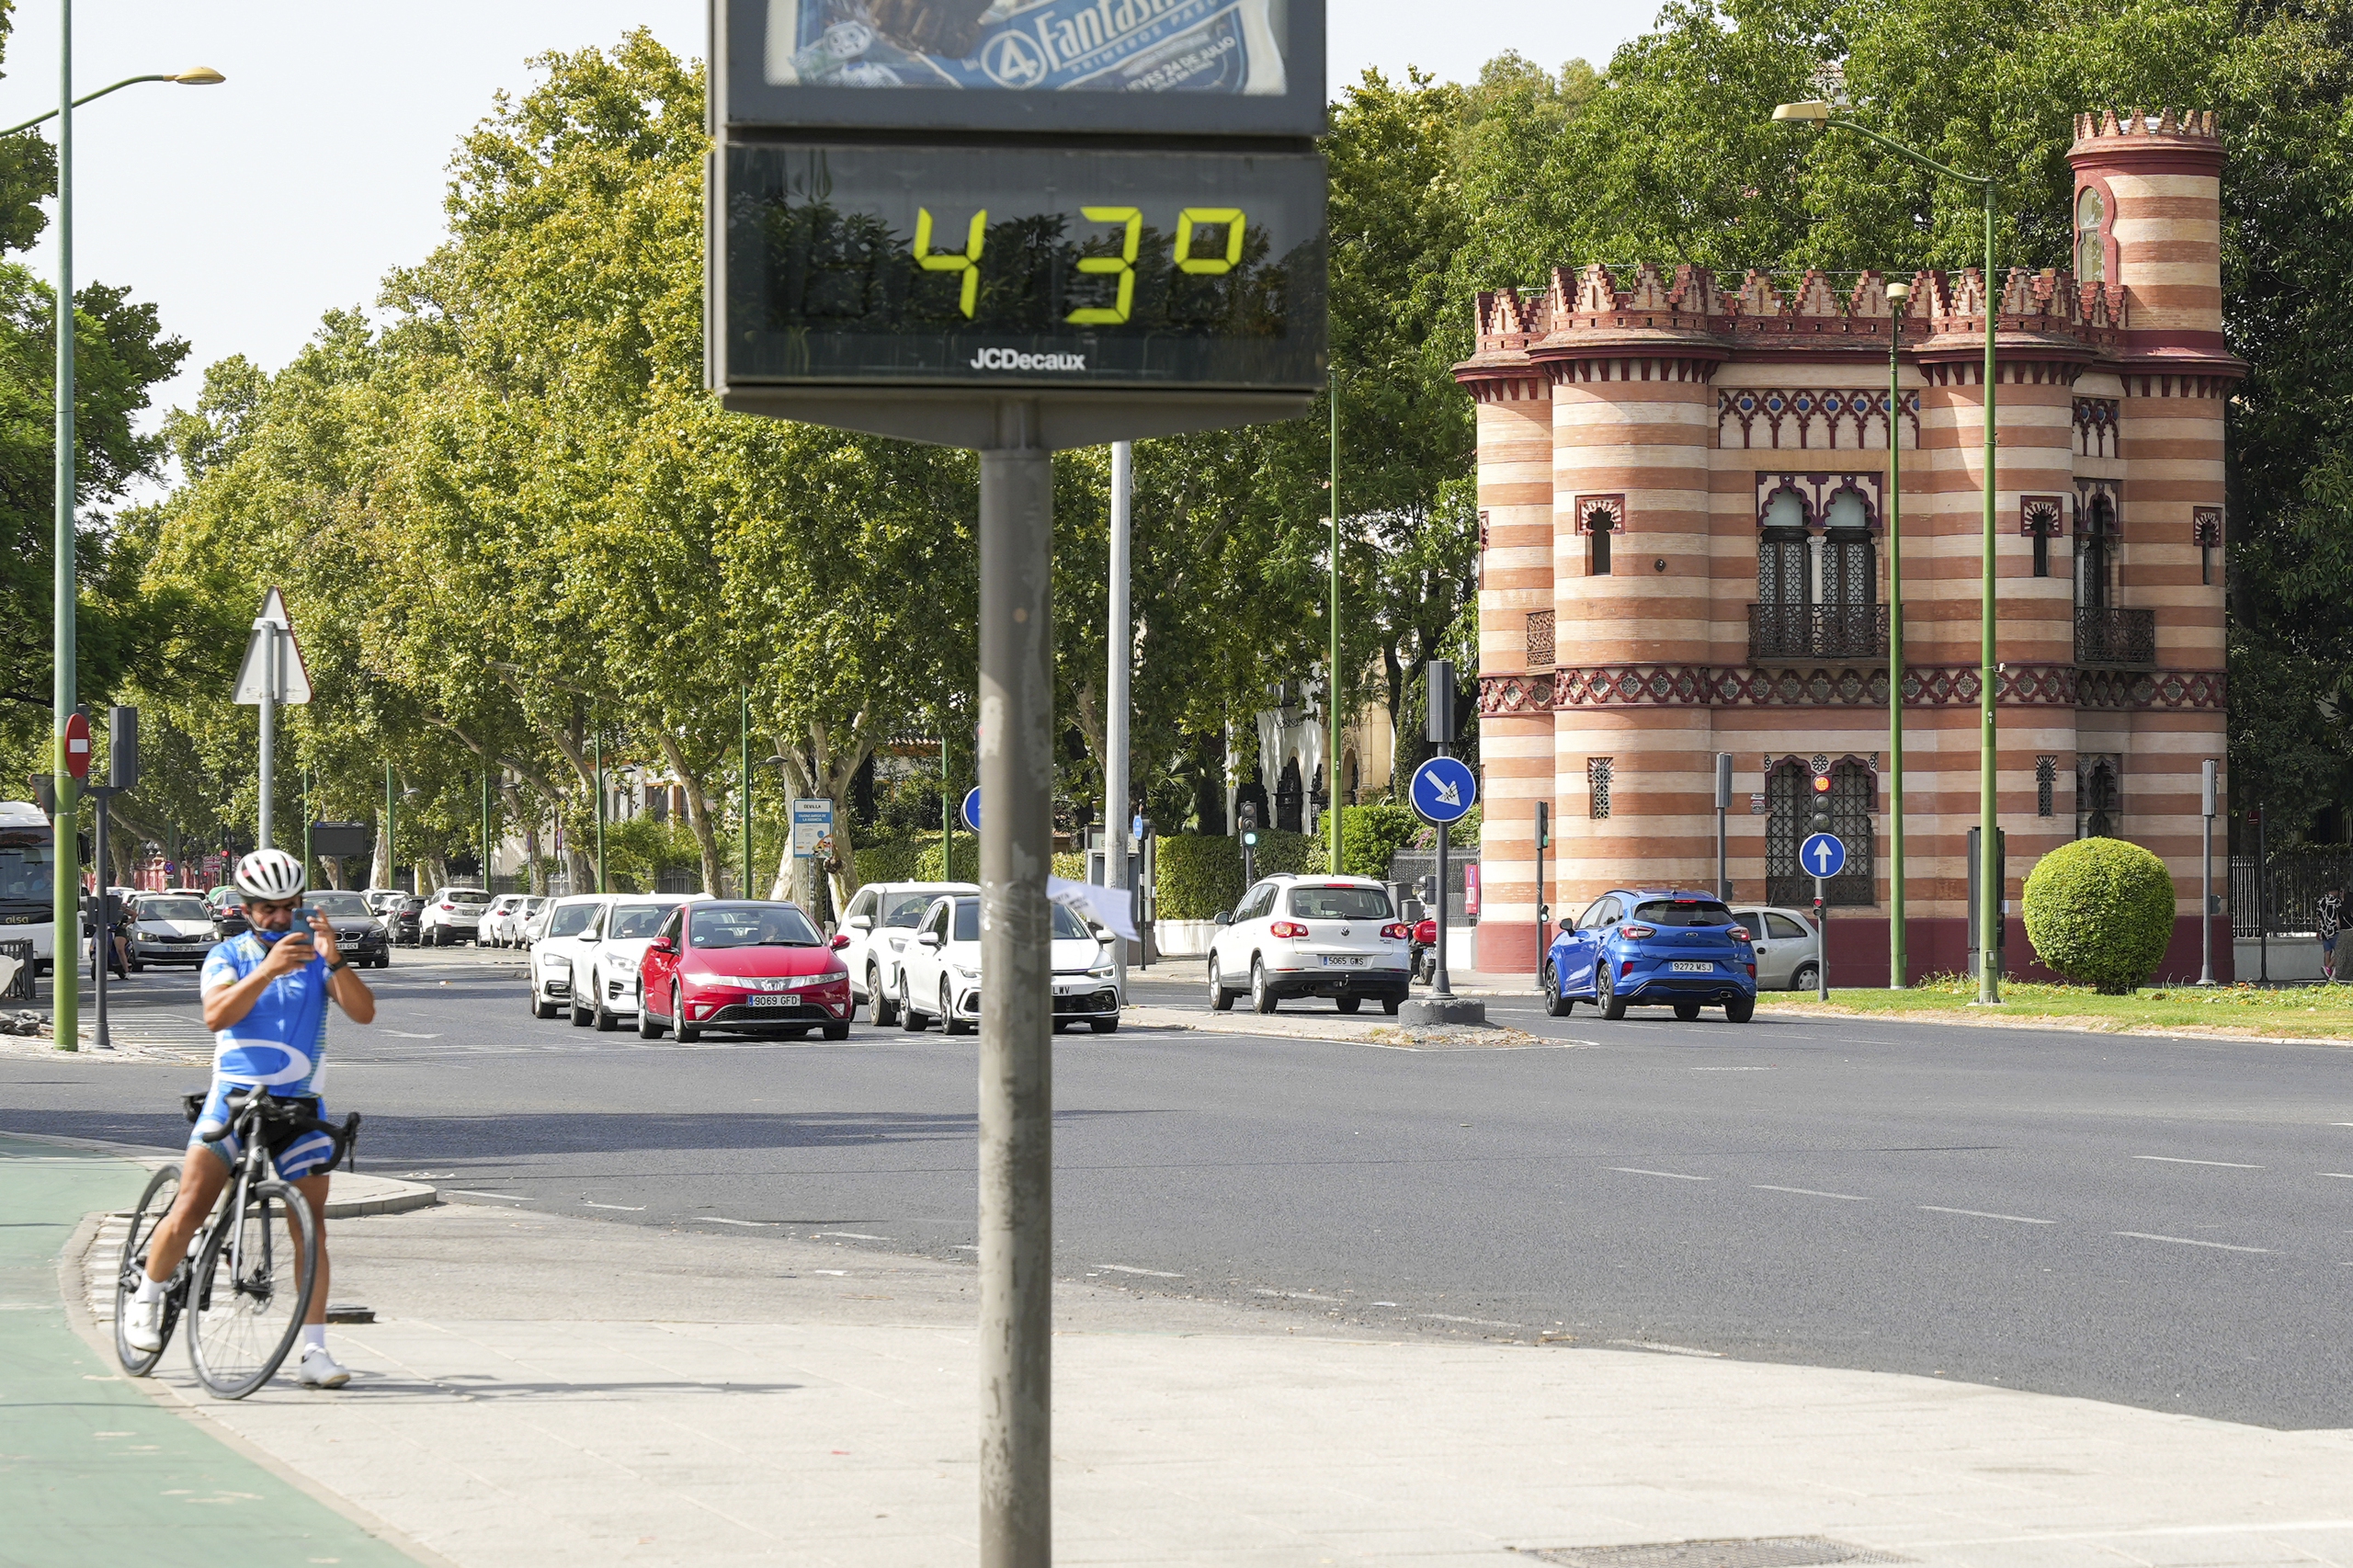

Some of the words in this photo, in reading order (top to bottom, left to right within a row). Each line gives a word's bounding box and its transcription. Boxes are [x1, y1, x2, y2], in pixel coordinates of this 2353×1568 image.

[1071, 25, 1162, 74] PRIMEROS
[1169, 0, 1226, 27] PASO
[1162, 61, 1183, 77] 24
[1178, 53, 1200, 69] DE
[1199, 36, 1236, 60] JULIO
[970, 347, 1086, 370] JCDecaux
[6, 915, 29, 925] alsa
[1328, 956, 1347, 965] 5065
[1674, 962, 1695, 971] 9272
[755, 996, 778, 1006] 9069
[780, 996, 798, 1006] GFD
